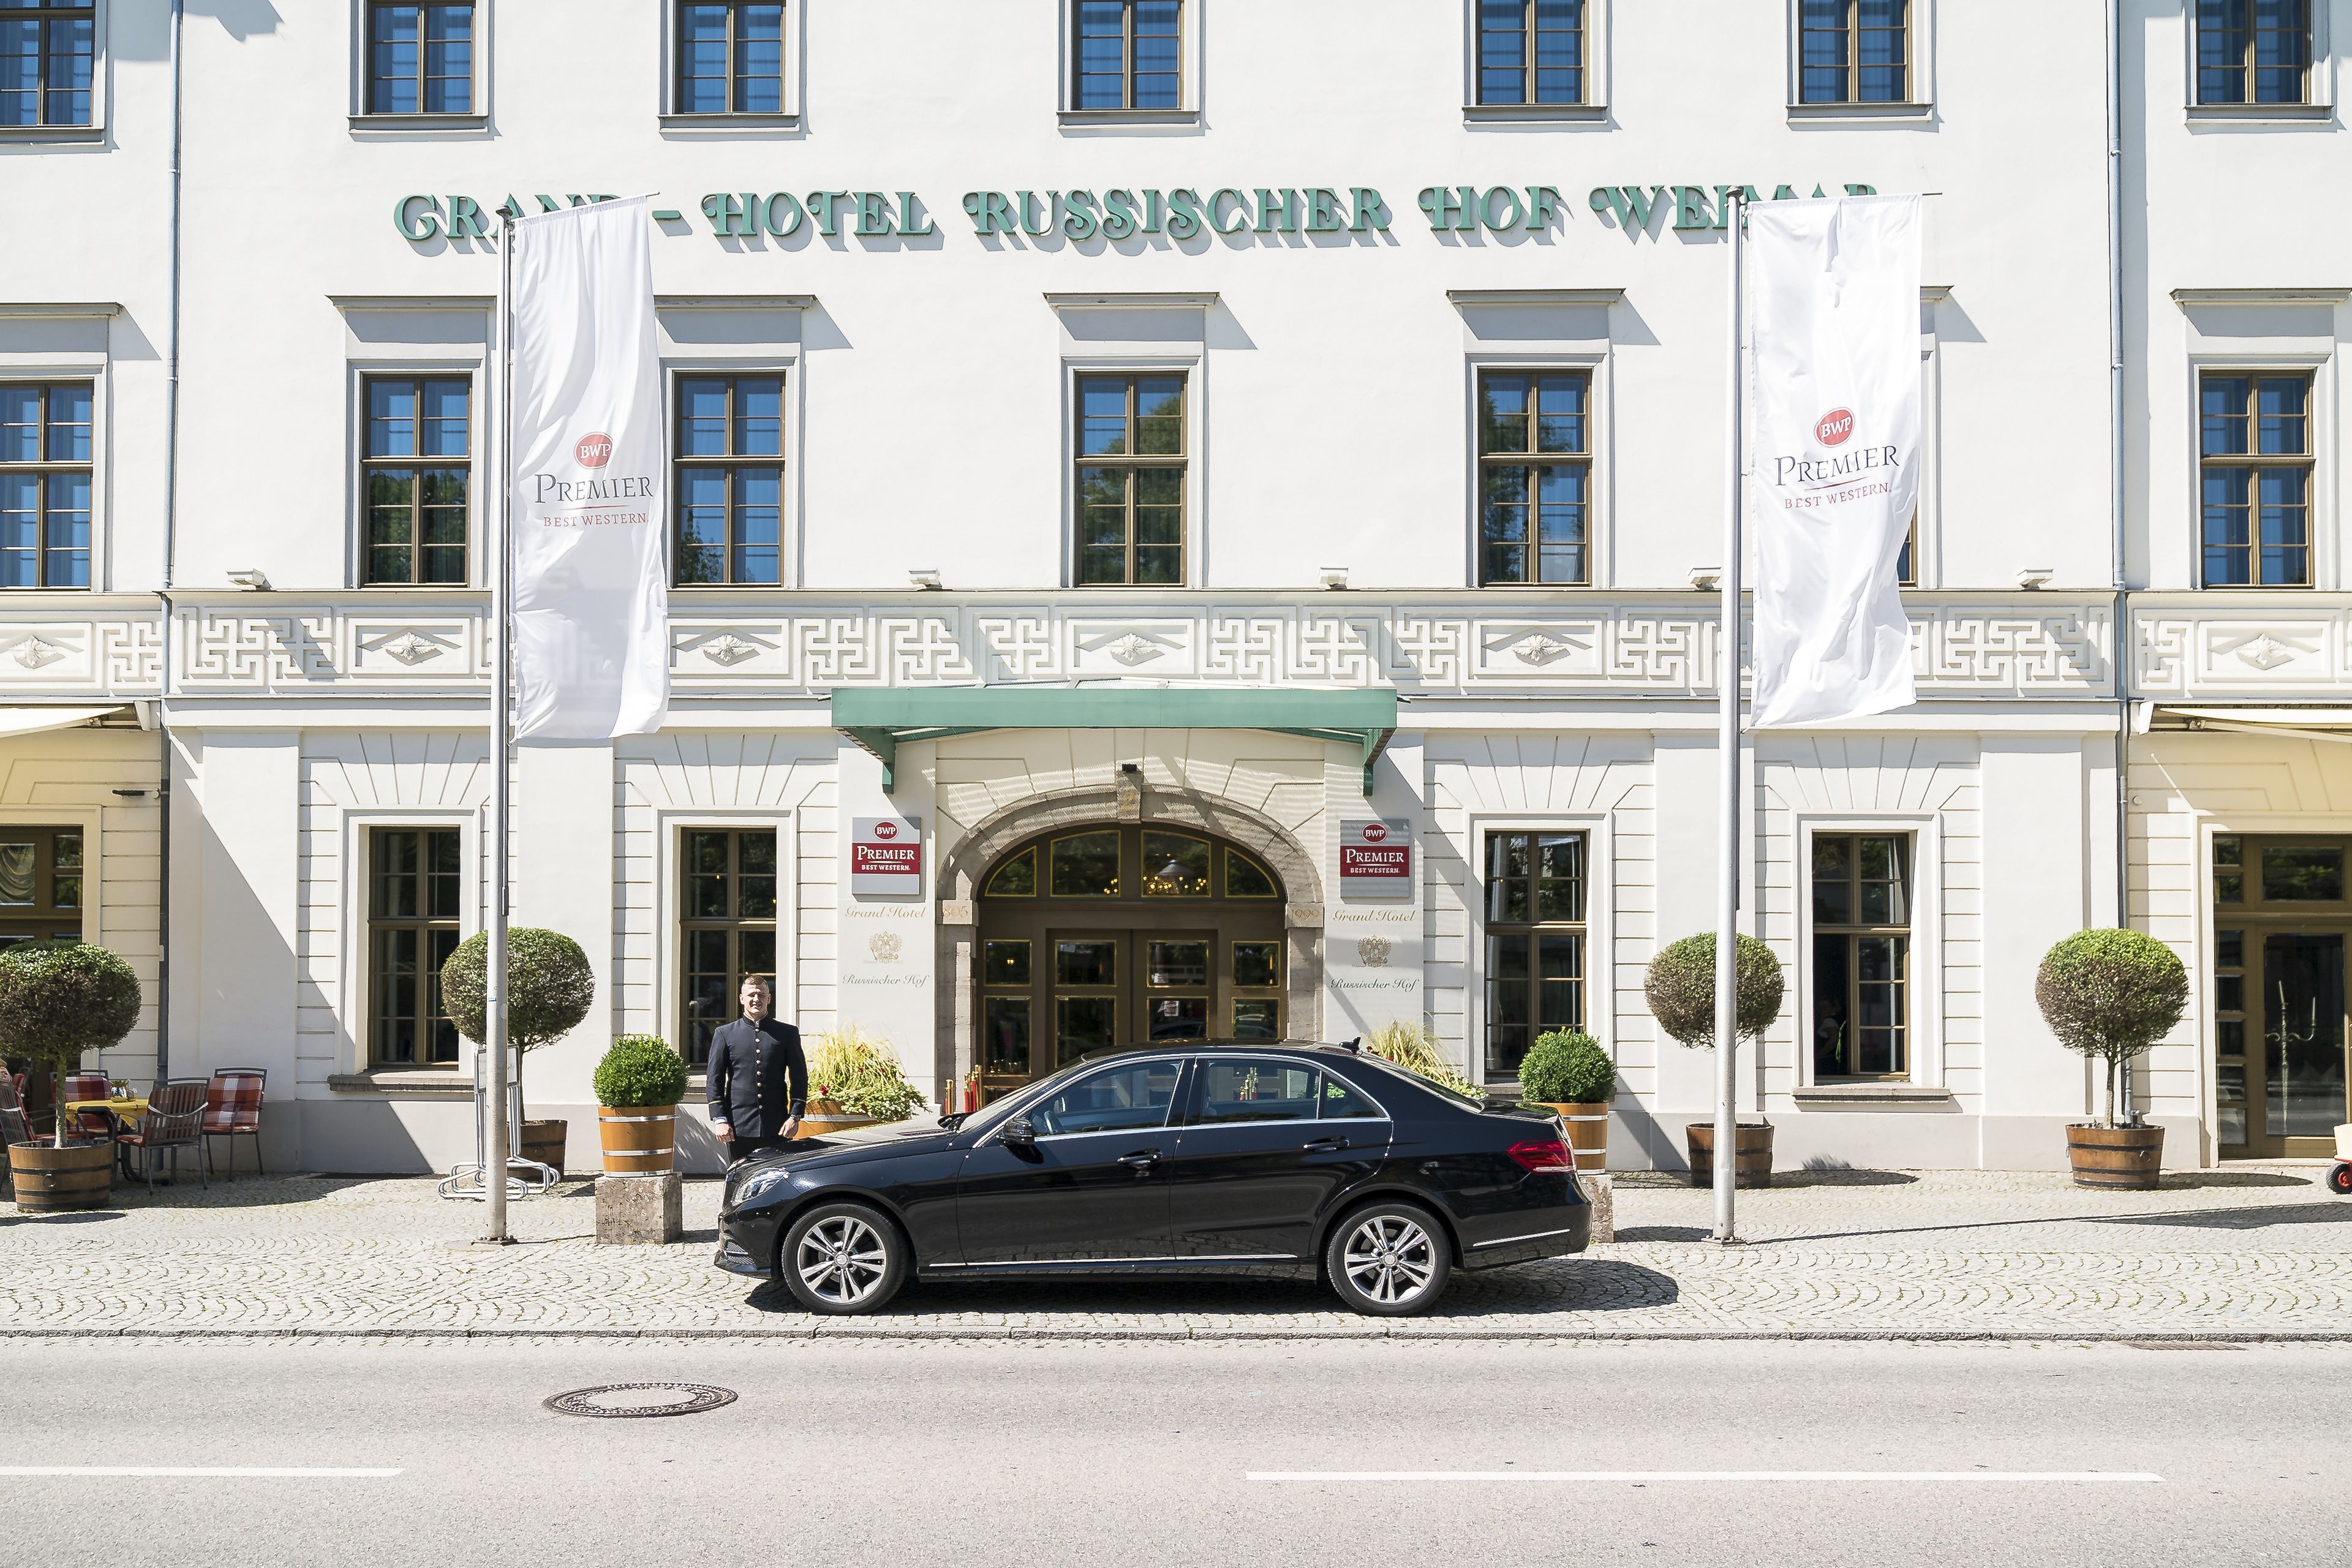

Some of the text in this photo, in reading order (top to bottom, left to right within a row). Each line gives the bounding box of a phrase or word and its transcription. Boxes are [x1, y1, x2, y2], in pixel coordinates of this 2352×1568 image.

[701, 189, 934, 236] HOTEL
[962, 188, 1389, 241] RUSSISCHER
[1417, 186, 1561, 231] HOF
[1820, 417, 1852, 439] BWP
[580, 443, 611, 459] BWP
[1774, 445, 1900, 486] PREMIER
[534, 474, 654, 503] PREMIER
[1784, 483, 1890, 509] BEST WESTERN
[544, 513, 647, 527] BEST WESTERN
[857, 846, 915, 860] PREMIER
[1345, 849, 1404, 863] PREMIER
[845, 906, 926, 918] Grand Hotel
[1333, 910, 1415, 921] Grand Hotel
[842, 974, 930, 988] Russischer Hof
[1330, 978, 1420, 992] Russischer Hof
